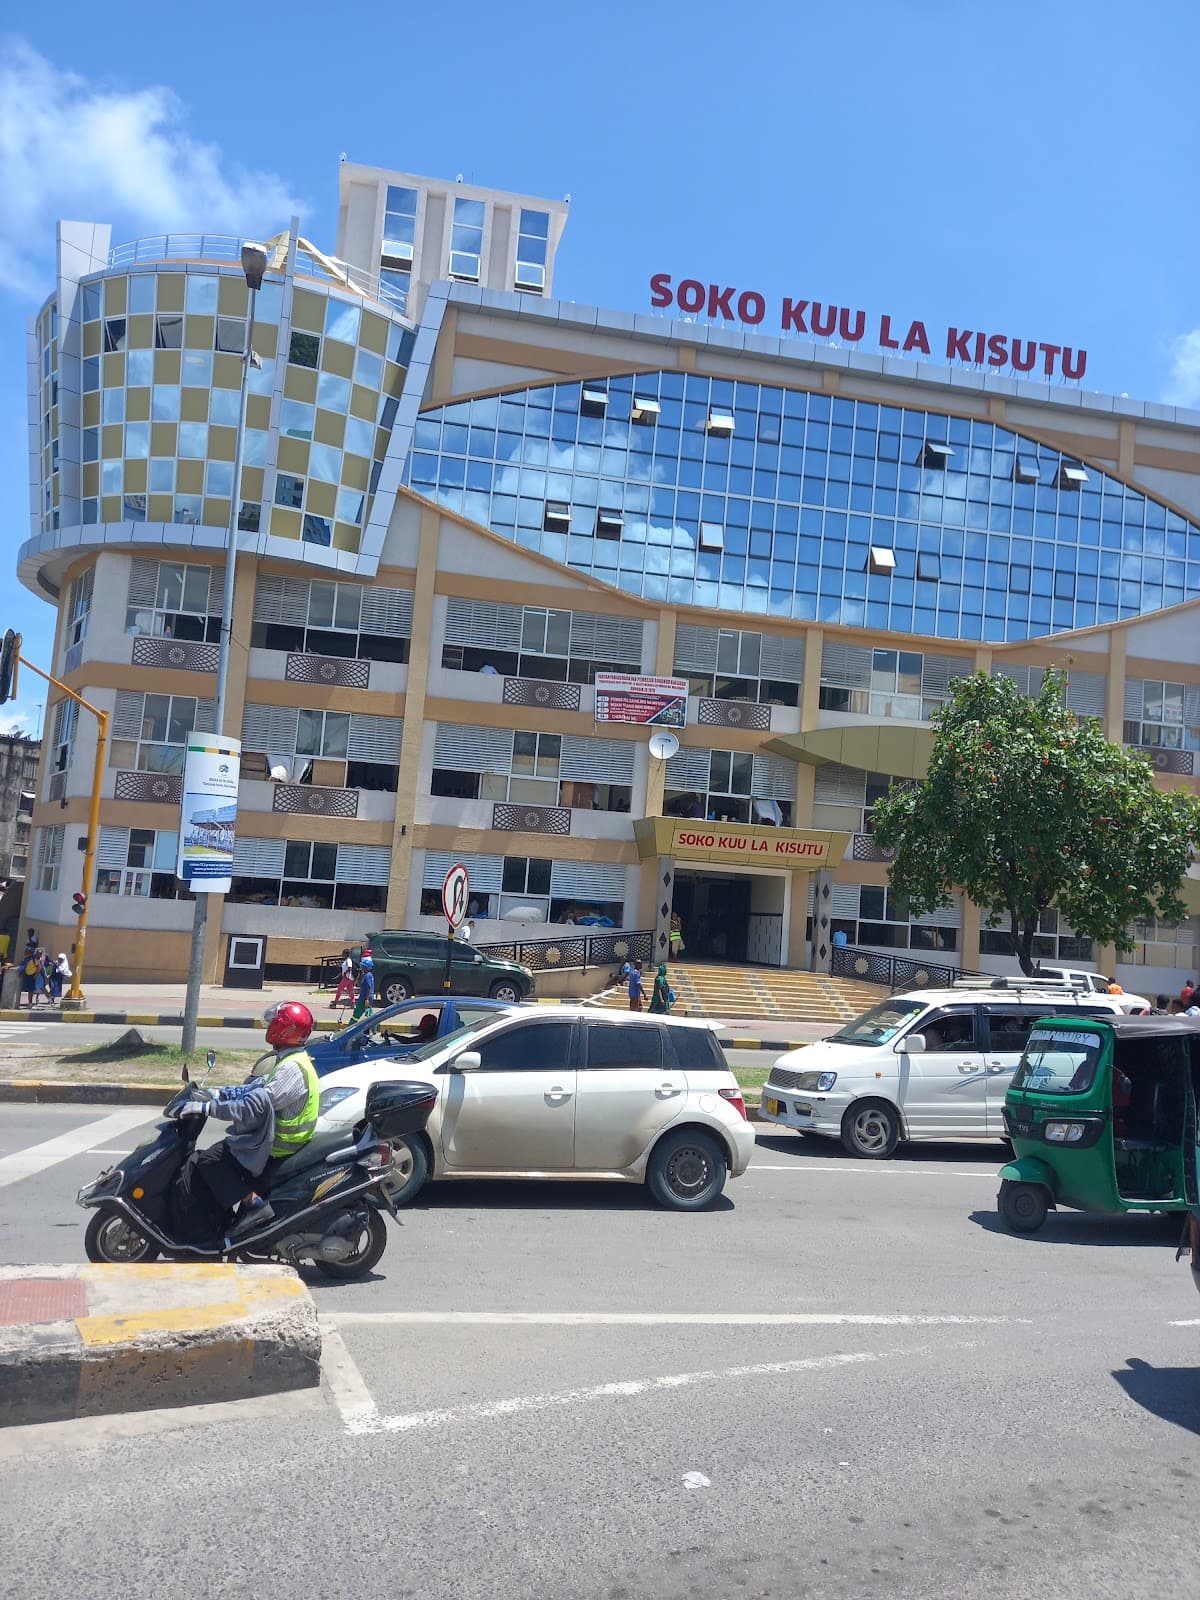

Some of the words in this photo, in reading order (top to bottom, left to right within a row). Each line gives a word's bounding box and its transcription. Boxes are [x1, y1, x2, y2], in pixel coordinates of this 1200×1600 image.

[650, 273, 765, 325] SOKO
[781, 297, 866, 342] KUU
[879, 314, 930, 355] LA
[946, 327, 1087, 380] KISUTU
[678, 833, 715, 847] SOKO
[718, 837, 747, 850] KUU
[751, 840, 769, 851] LA
[775, 841, 824, 856] KISUTU
